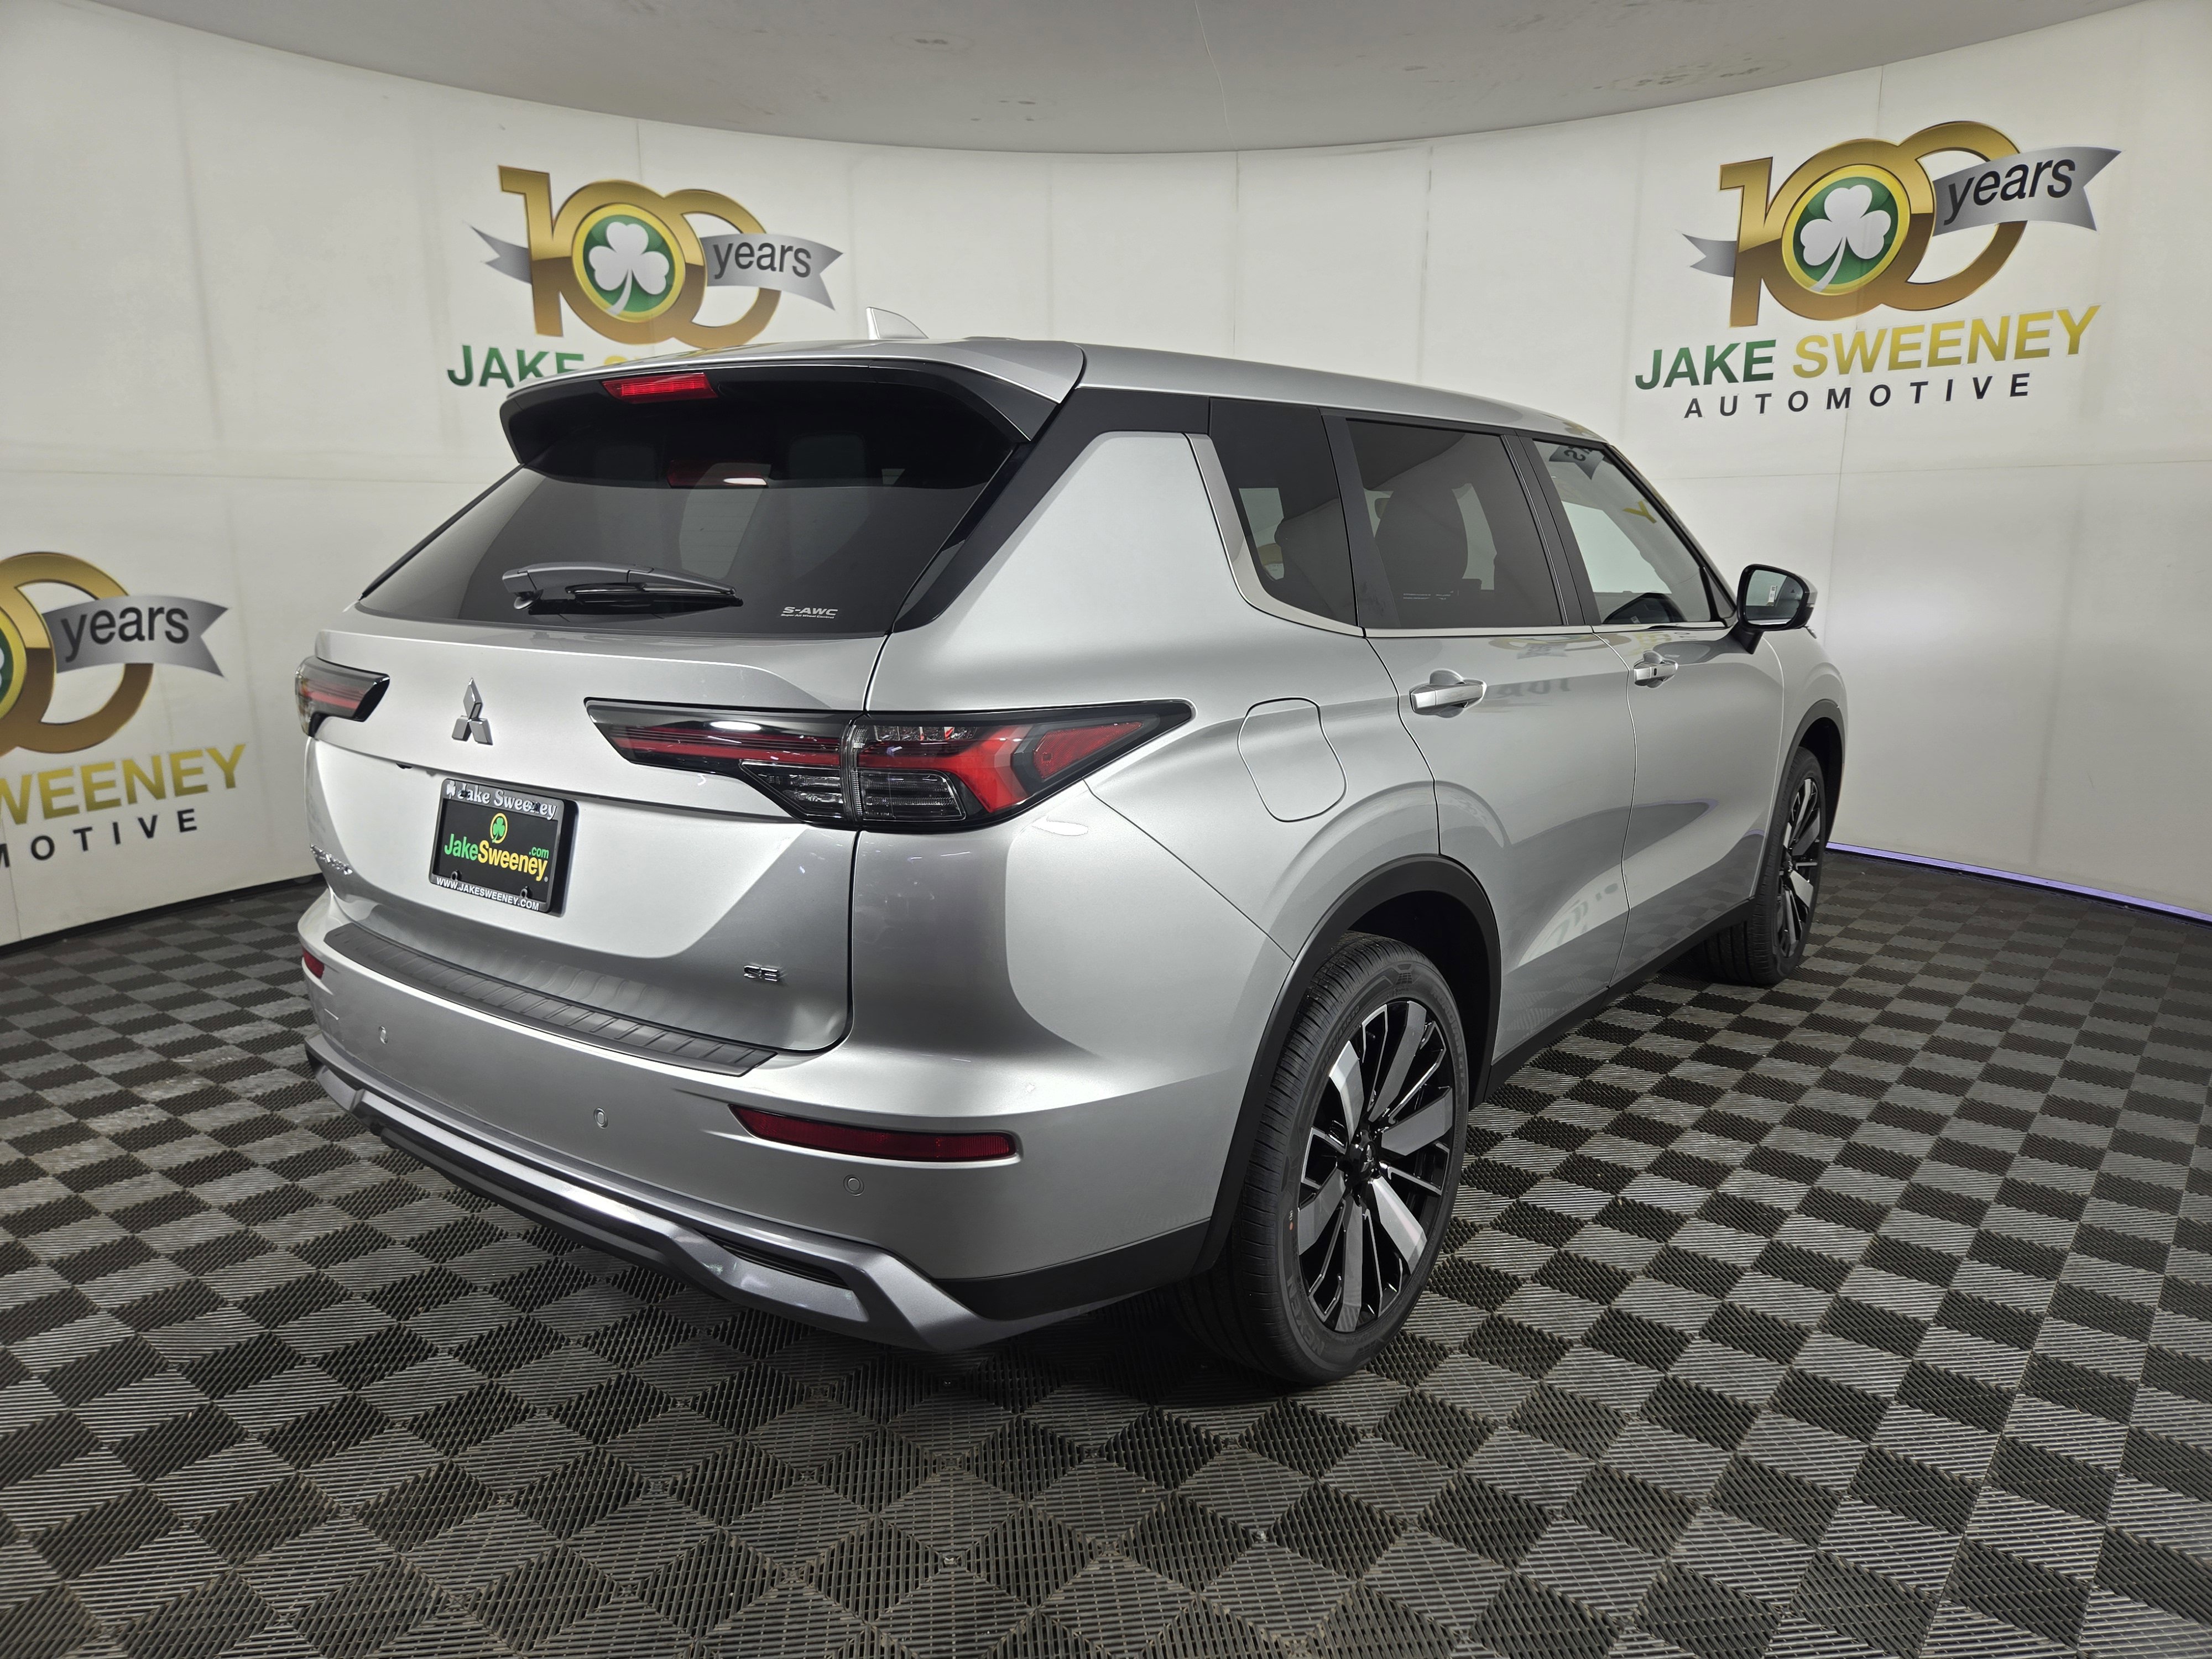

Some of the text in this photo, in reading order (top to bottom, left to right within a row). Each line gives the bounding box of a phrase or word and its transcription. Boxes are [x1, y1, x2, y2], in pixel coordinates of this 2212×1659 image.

[1943, 155, 2076, 225] years
[713, 240, 812, 279] years
[1635, 305, 2101, 390] JAKE SWEENEY
[1684, 372, 2031, 419] AUTOMOTIVE
[61, 606, 190, 662] years
[782, 607, 838, 615] S-AWC
[457, 782, 491, 804] Jake
[444, 833, 548, 883] JakeSweeney
[436, 877, 540, 911] WWW.JAKESWEENEY.COM
